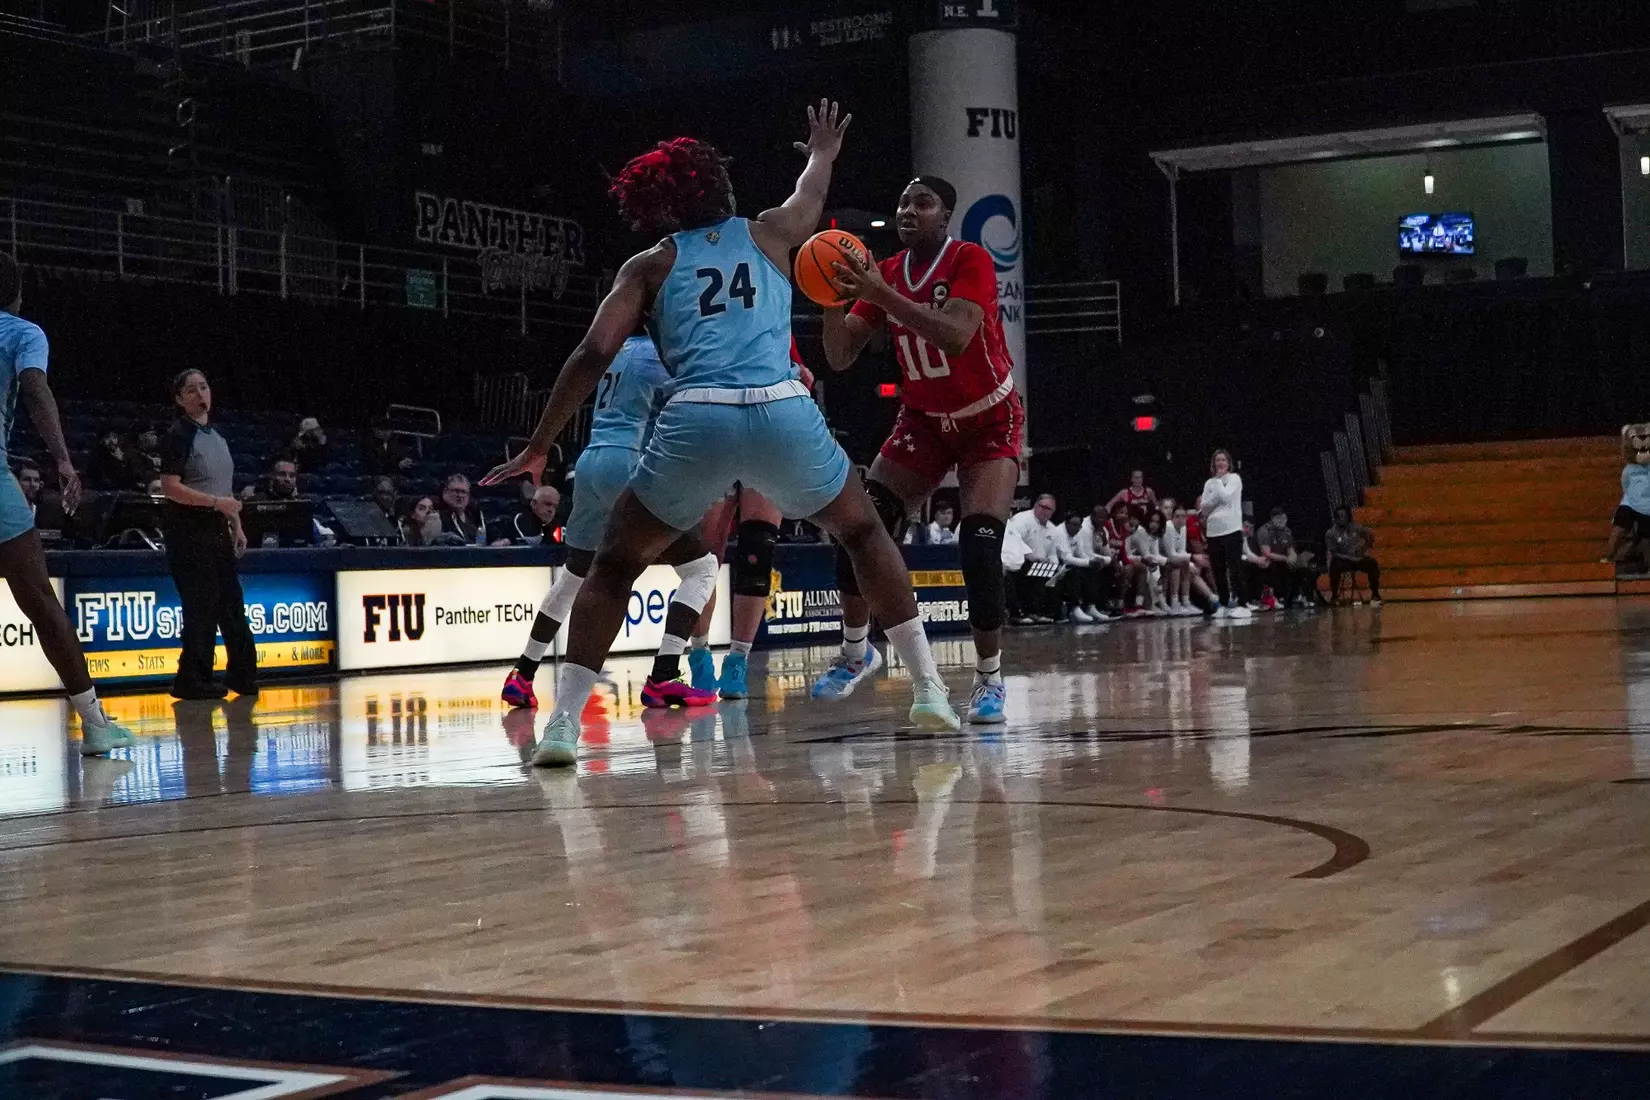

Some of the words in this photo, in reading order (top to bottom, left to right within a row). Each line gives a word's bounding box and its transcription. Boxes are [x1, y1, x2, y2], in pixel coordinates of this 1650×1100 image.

[965, 107, 1016, 139] FIU
[415, 192, 585, 267] PANTHER
[696, 262, 757, 317] 24
[996, 281, 1023, 300] EAN
[998, 304, 1022, 324] NK
[897, 334, 951, 381] 10
[598, 371, 621, 409] 21
[75, 591, 328, 642] FIUSS.COM
[362, 593, 426, 643] FIU
[435, 606, 491, 625] Panther
[494, 603, 534, 622] TECH
[625, 589, 678, 637] pe
[774, 590, 804, 619] FIU
[804, 589, 841, 606] ALUMN
[0, 623, 34, 646] CH
